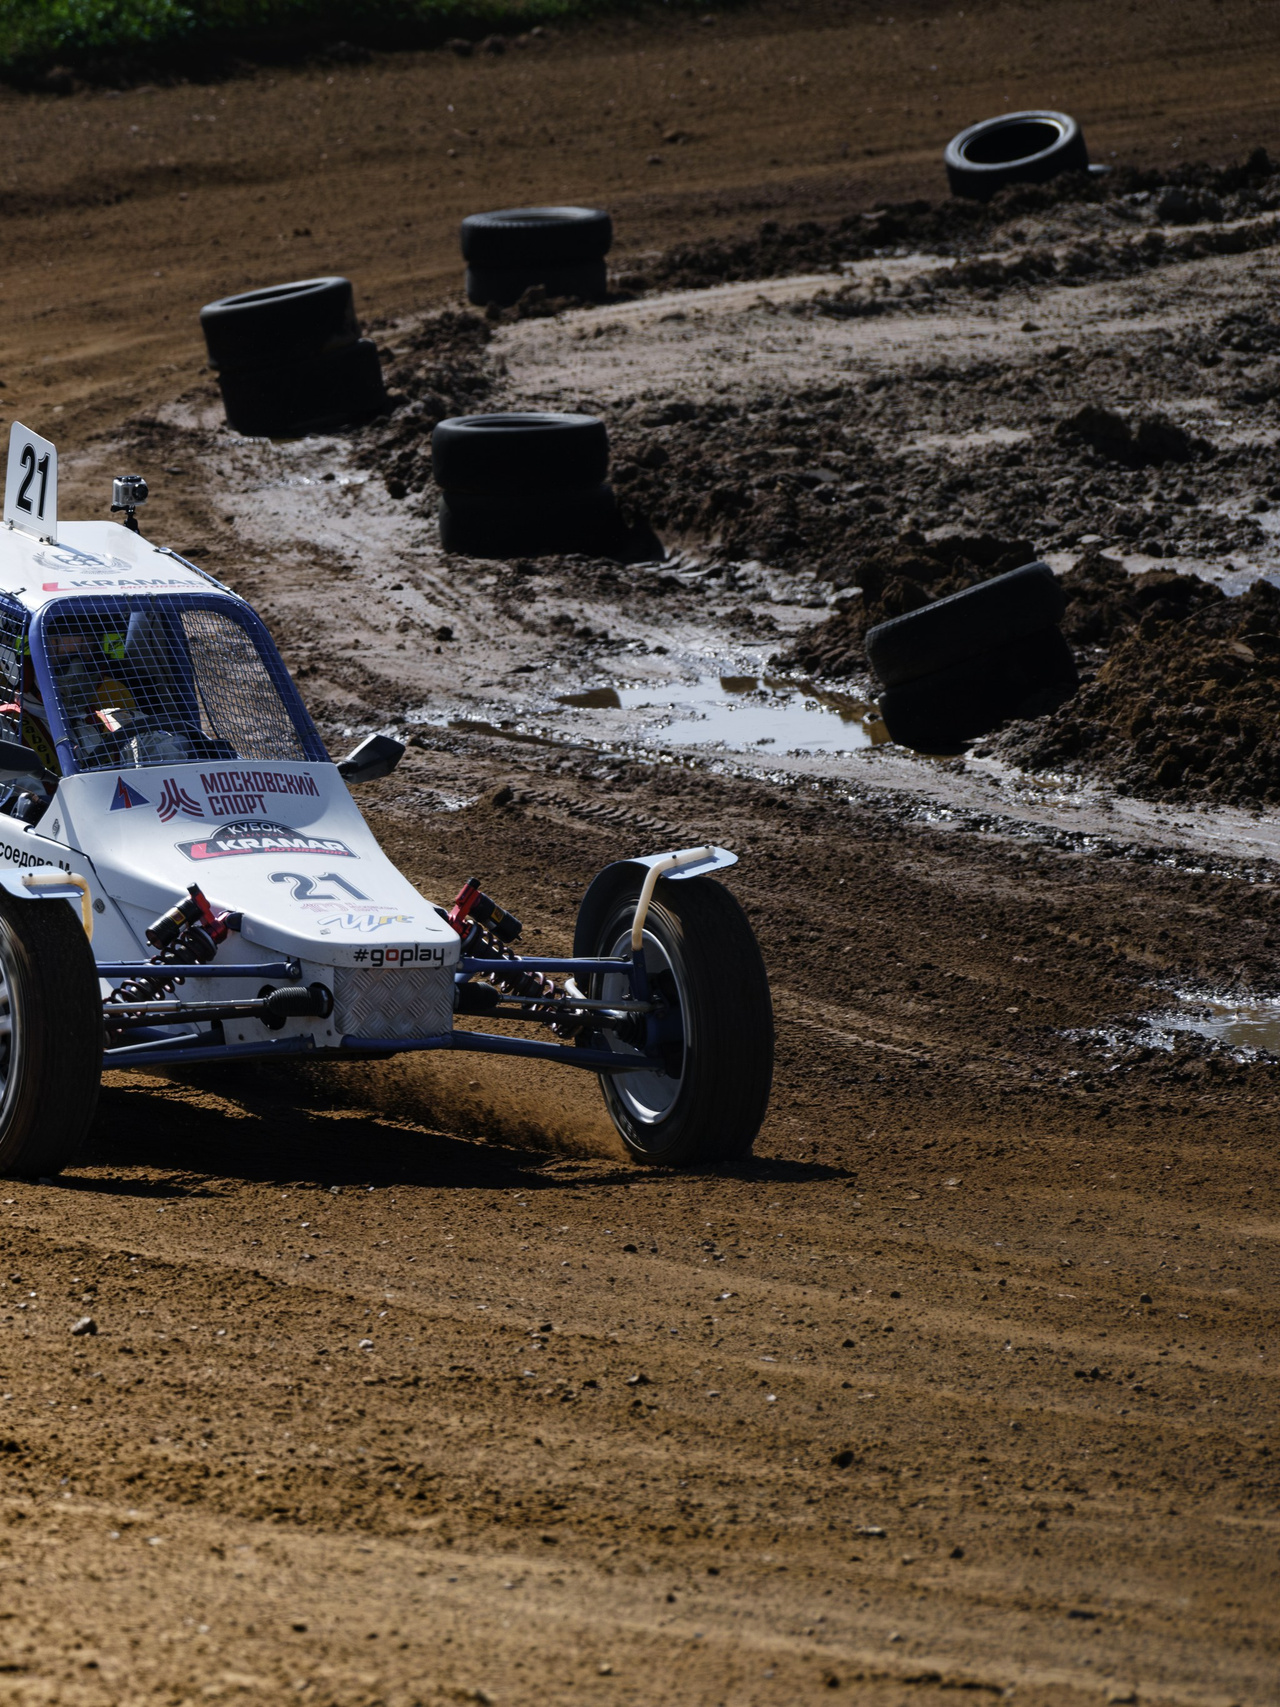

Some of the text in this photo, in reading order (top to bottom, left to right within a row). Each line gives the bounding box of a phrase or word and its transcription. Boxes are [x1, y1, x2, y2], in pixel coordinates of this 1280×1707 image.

[16, 443, 50, 520] 21
[200, 771, 320, 797] МОСКОВСКИЙ
[208, 794, 267, 816] СПОРТ
[227, 822, 285, 835] КУБОК
[216, 837, 347, 852] KRAMAR
[264, 847, 350, 856] MOTORSPORT
[268, 872, 374, 902] 21
[353, 944, 445, 967] #goplay
